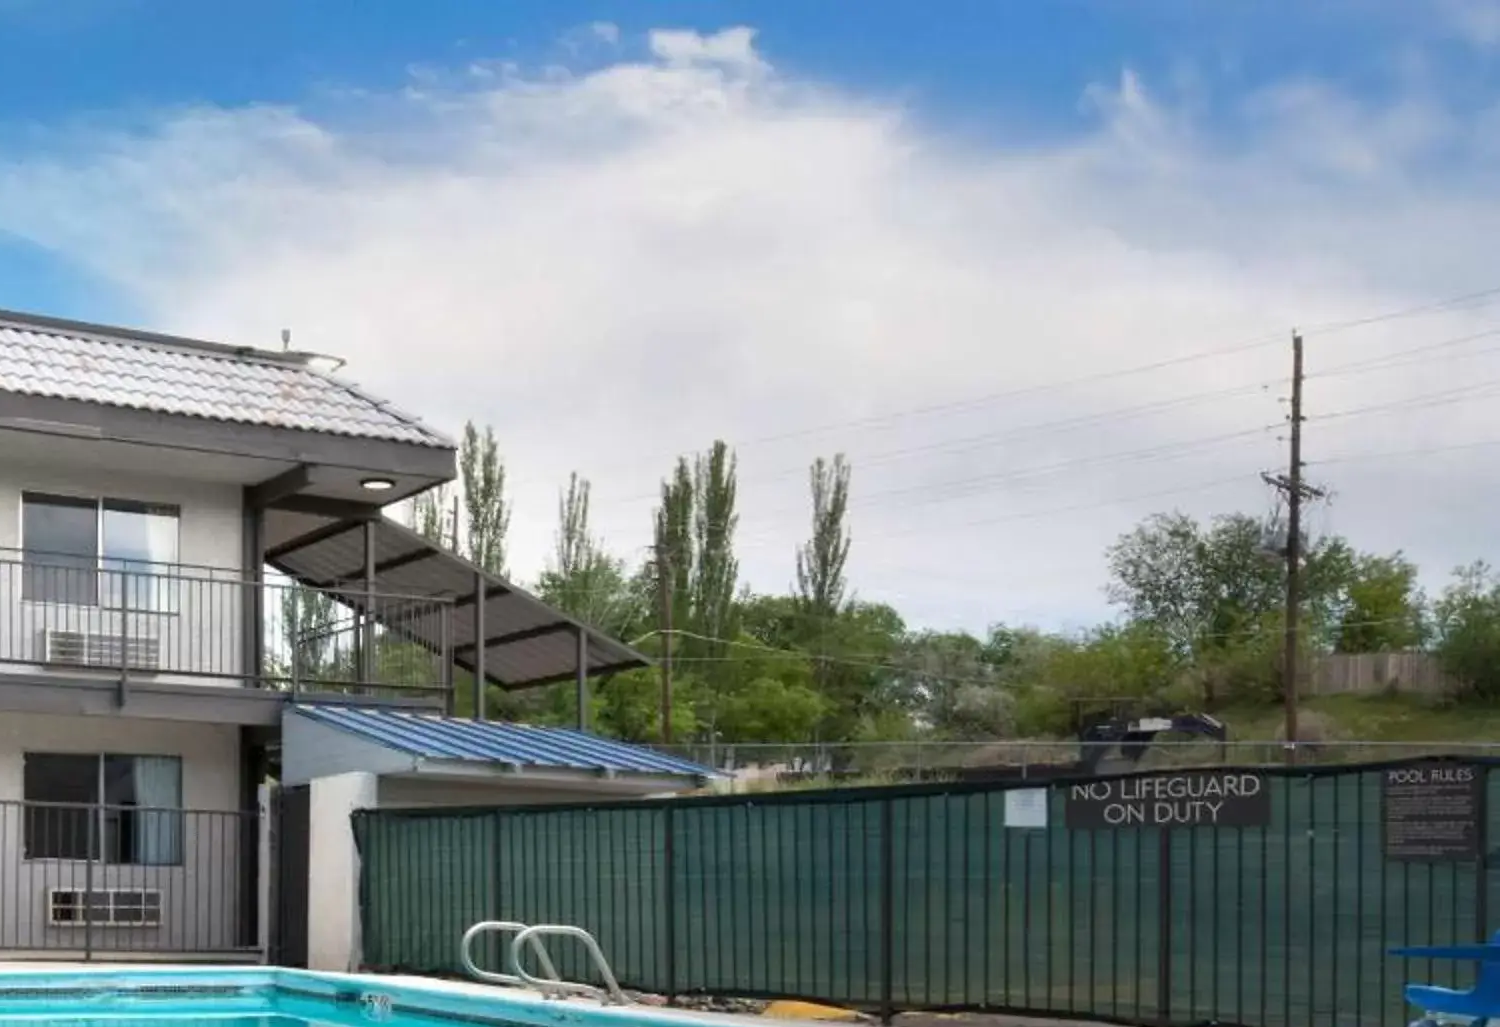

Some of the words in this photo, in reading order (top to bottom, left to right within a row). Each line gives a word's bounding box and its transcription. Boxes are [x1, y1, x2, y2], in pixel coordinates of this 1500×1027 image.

[1388, 768, 1427, 783] POOL
[1431, 766, 1474, 782] RULES
[1071, 782, 1112, 800] NO
[1120, 774, 1261, 800] LIFEGUARD
[1103, 803, 1145, 824] ON
[1154, 801, 1224, 824] DUTY
